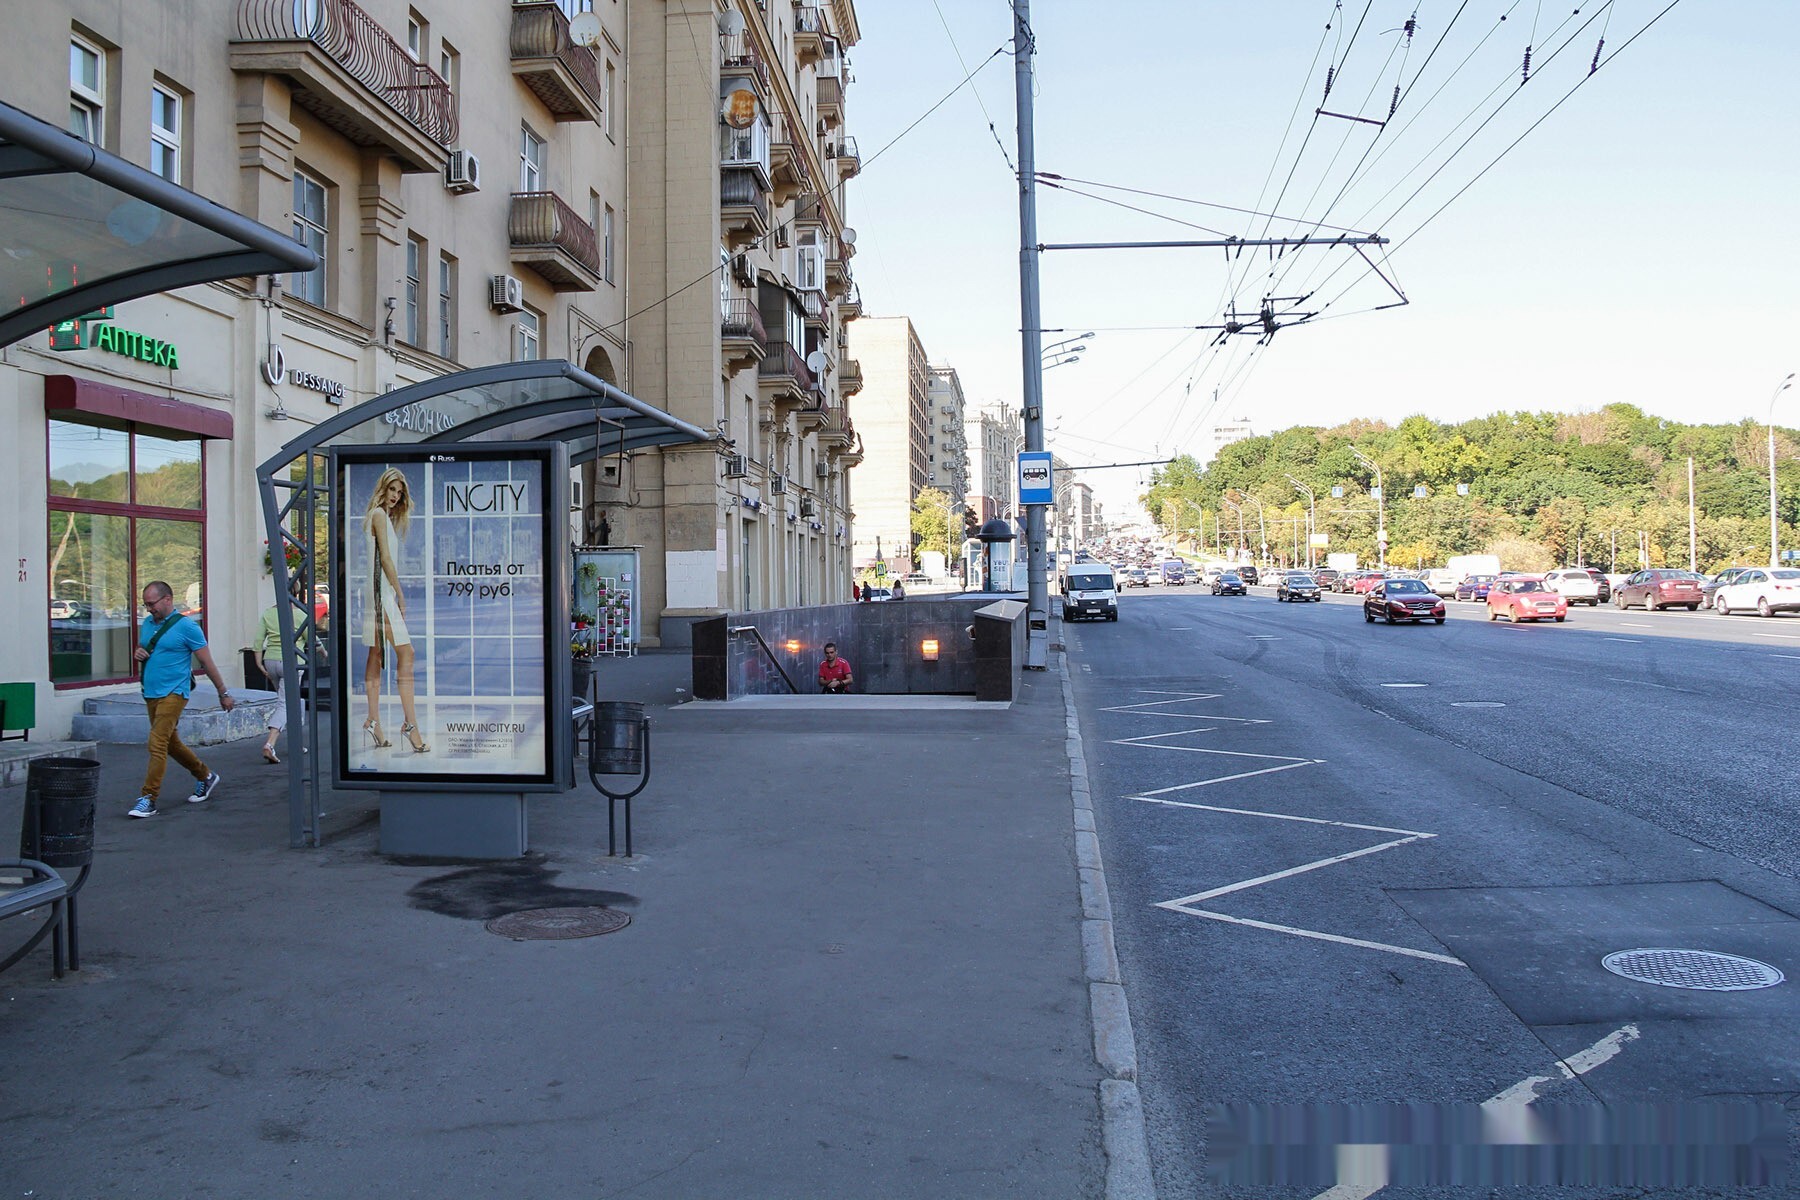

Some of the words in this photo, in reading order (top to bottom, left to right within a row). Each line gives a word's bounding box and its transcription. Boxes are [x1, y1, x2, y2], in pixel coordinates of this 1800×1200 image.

[97, 323, 179, 369] АПТЕКА
[295, 369, 346, 398] DESSANGE
[447, 484, 525, 512] INCITY
[447, 562, 501, 575] Платья
[507, 564, 525, 575] от
[447, 582, 474, 597] 799
[480, 582, 514, 600] руб.
[446, 723, 525, 733] WWW.INCITY.RU
